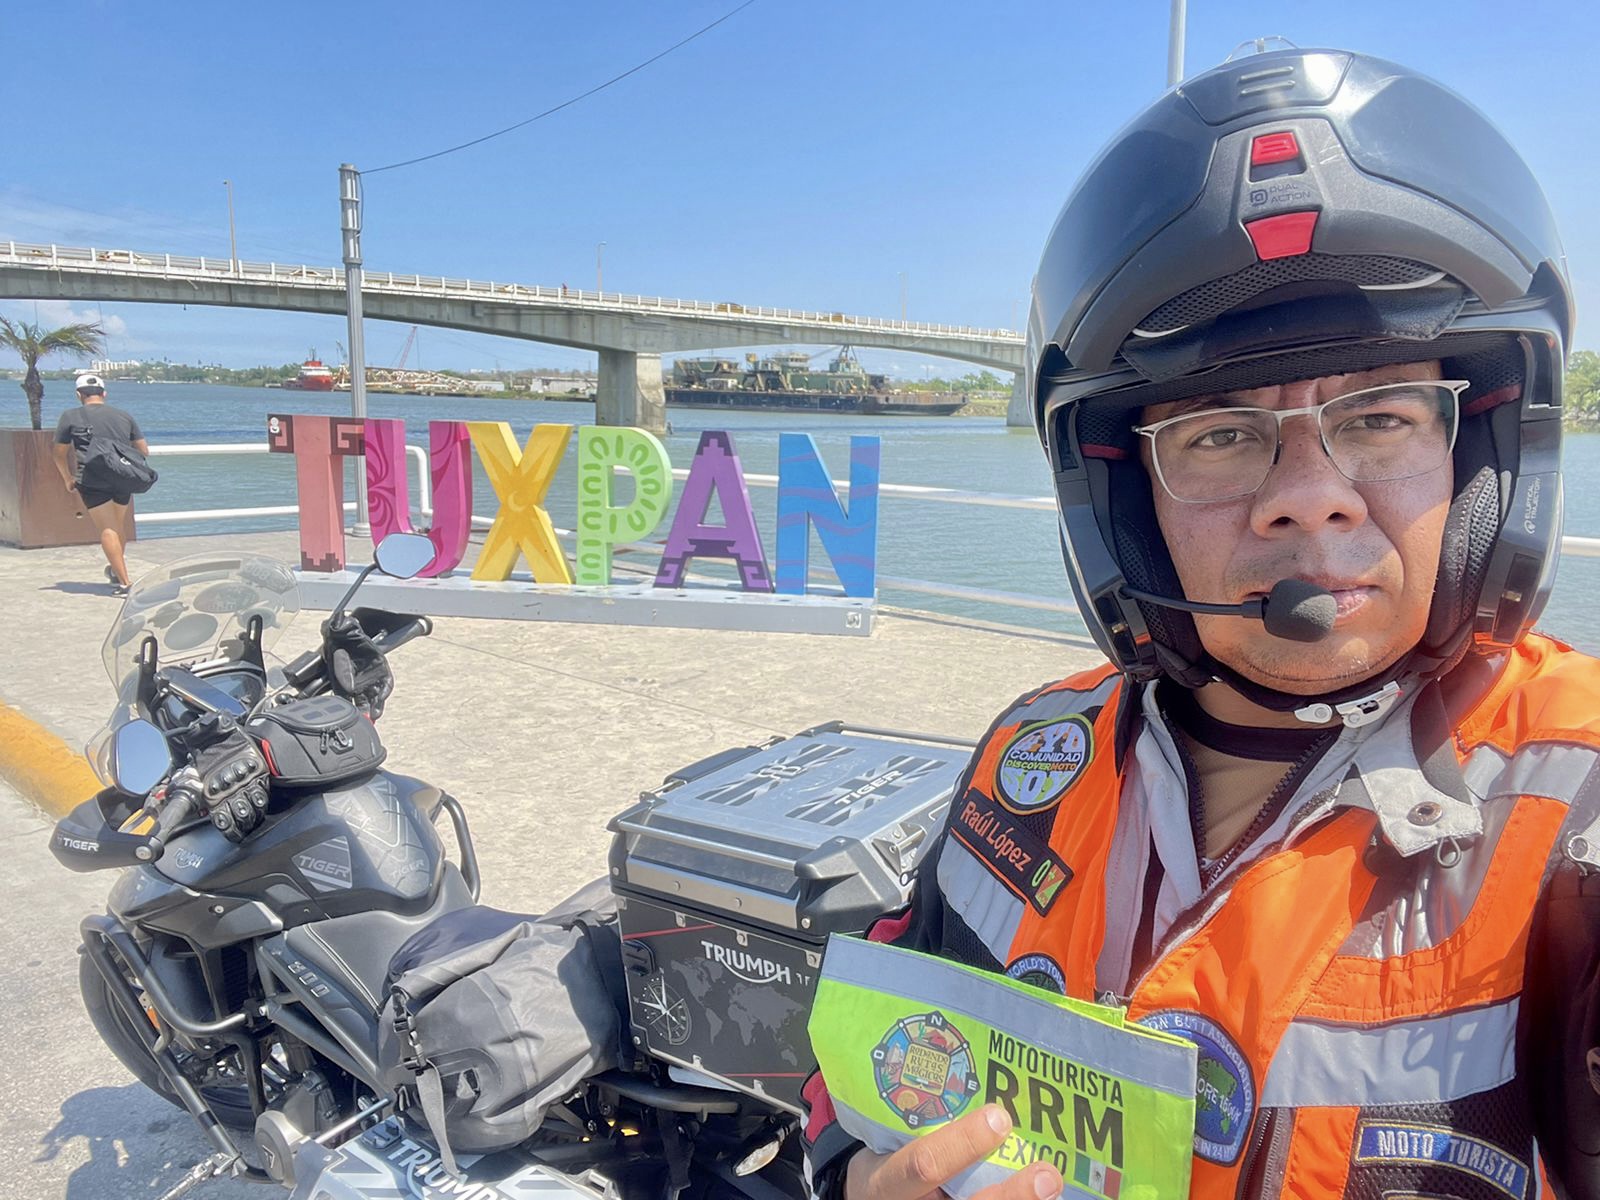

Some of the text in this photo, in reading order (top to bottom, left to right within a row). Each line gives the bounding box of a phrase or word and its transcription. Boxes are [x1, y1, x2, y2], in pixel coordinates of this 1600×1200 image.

[1271, 191, 1311, 204] ACTION
[267, 413, 881, 597] TUXPAN
[1006, 759, 1077, 771] DISCOVERMOTO
[1010, 750, 1082, 762] COMUNIDAD
[833, 769, 904, 806] TIGER
[63, 837, 100, 852] TIGER
[960, 800, 996, 837] Raúl
[985, 821, 1032, 872] López
[299, 855, 350, 879] TIGER
[391, 858, 425, 879] TIGER
[701, 940, 791, 985] TRIUMPH
[931, 1015, 943, 1026] N
[989, 1029, 1124, 1108] MOTOTURISTA
[967, 1080, 978, 1091] E
[908, 1114, 919, 1126] S
[985, 1058, 1124, 1169] RRM
[997, 1134, 1068, 1177] EXICO
[1377, 1130, 1518, 1188] MOTO TURISTA
